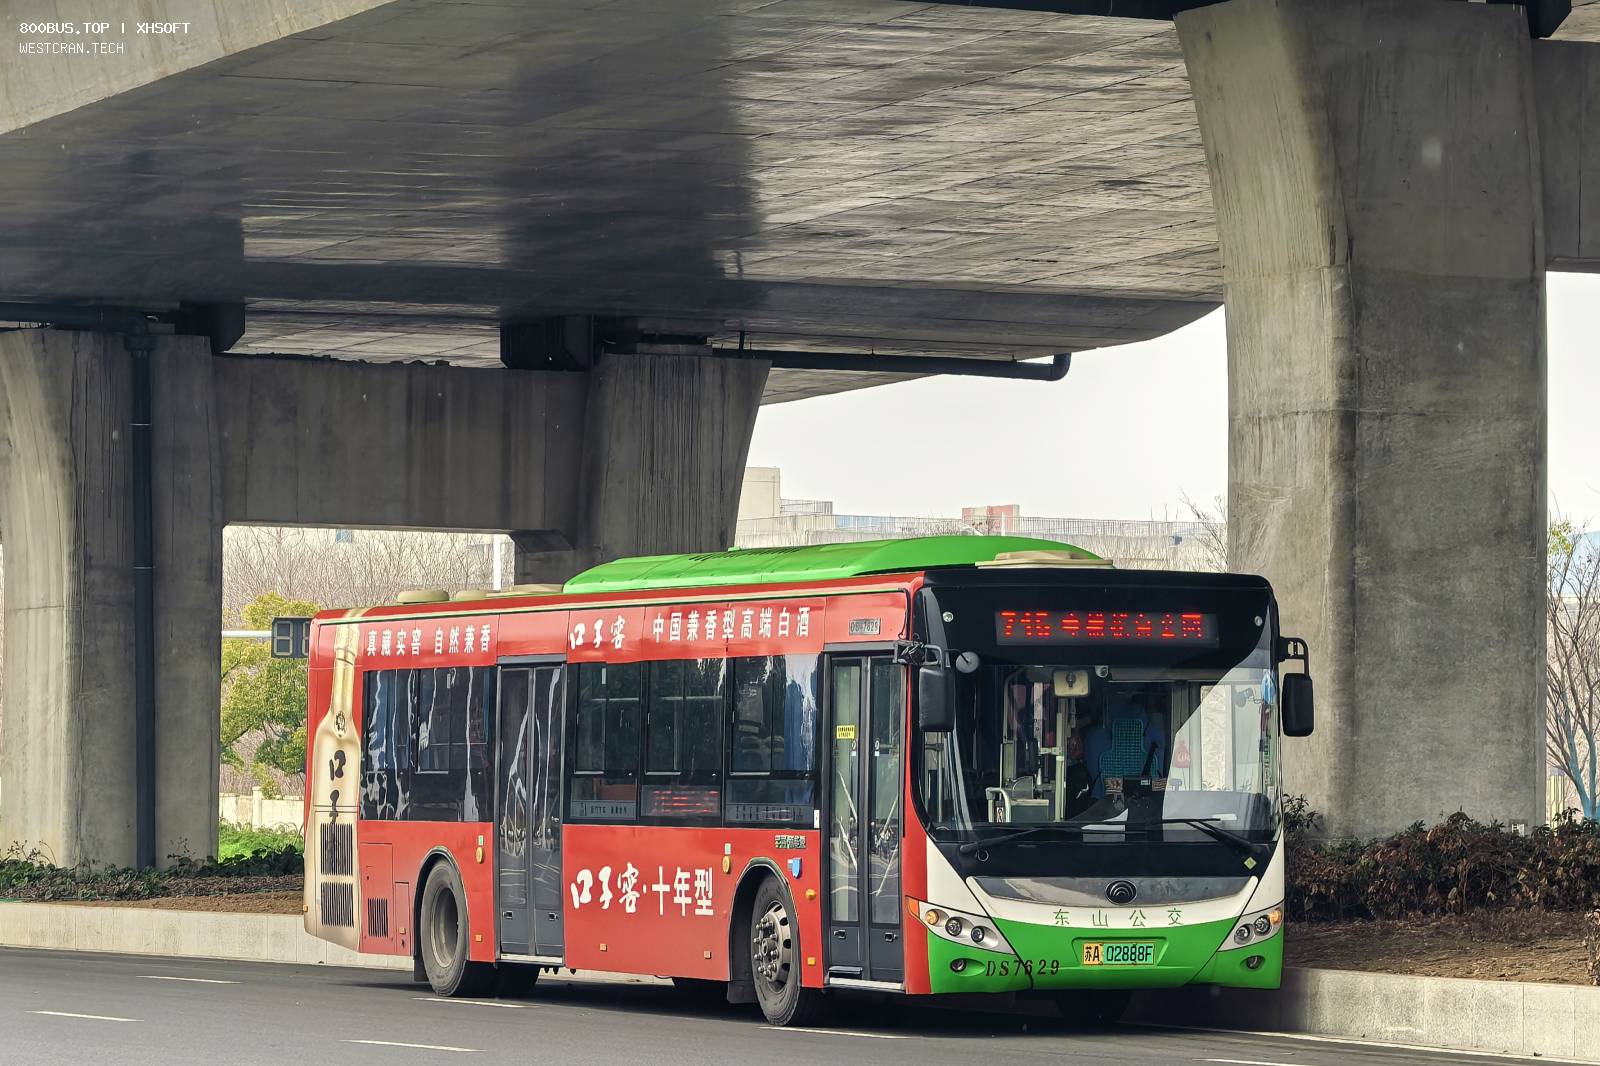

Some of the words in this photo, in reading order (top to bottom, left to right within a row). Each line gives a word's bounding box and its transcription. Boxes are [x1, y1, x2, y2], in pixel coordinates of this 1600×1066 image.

[652, 606, 811, 643] 中国兼香型高端白酒
[367, 626, 422, 656] 真藏实窖
[434, 623, 491, 655] 自然兼香
[1052, 907, 1184, 928] 东山公交
[986, 959, 1060, 977] DS7629
